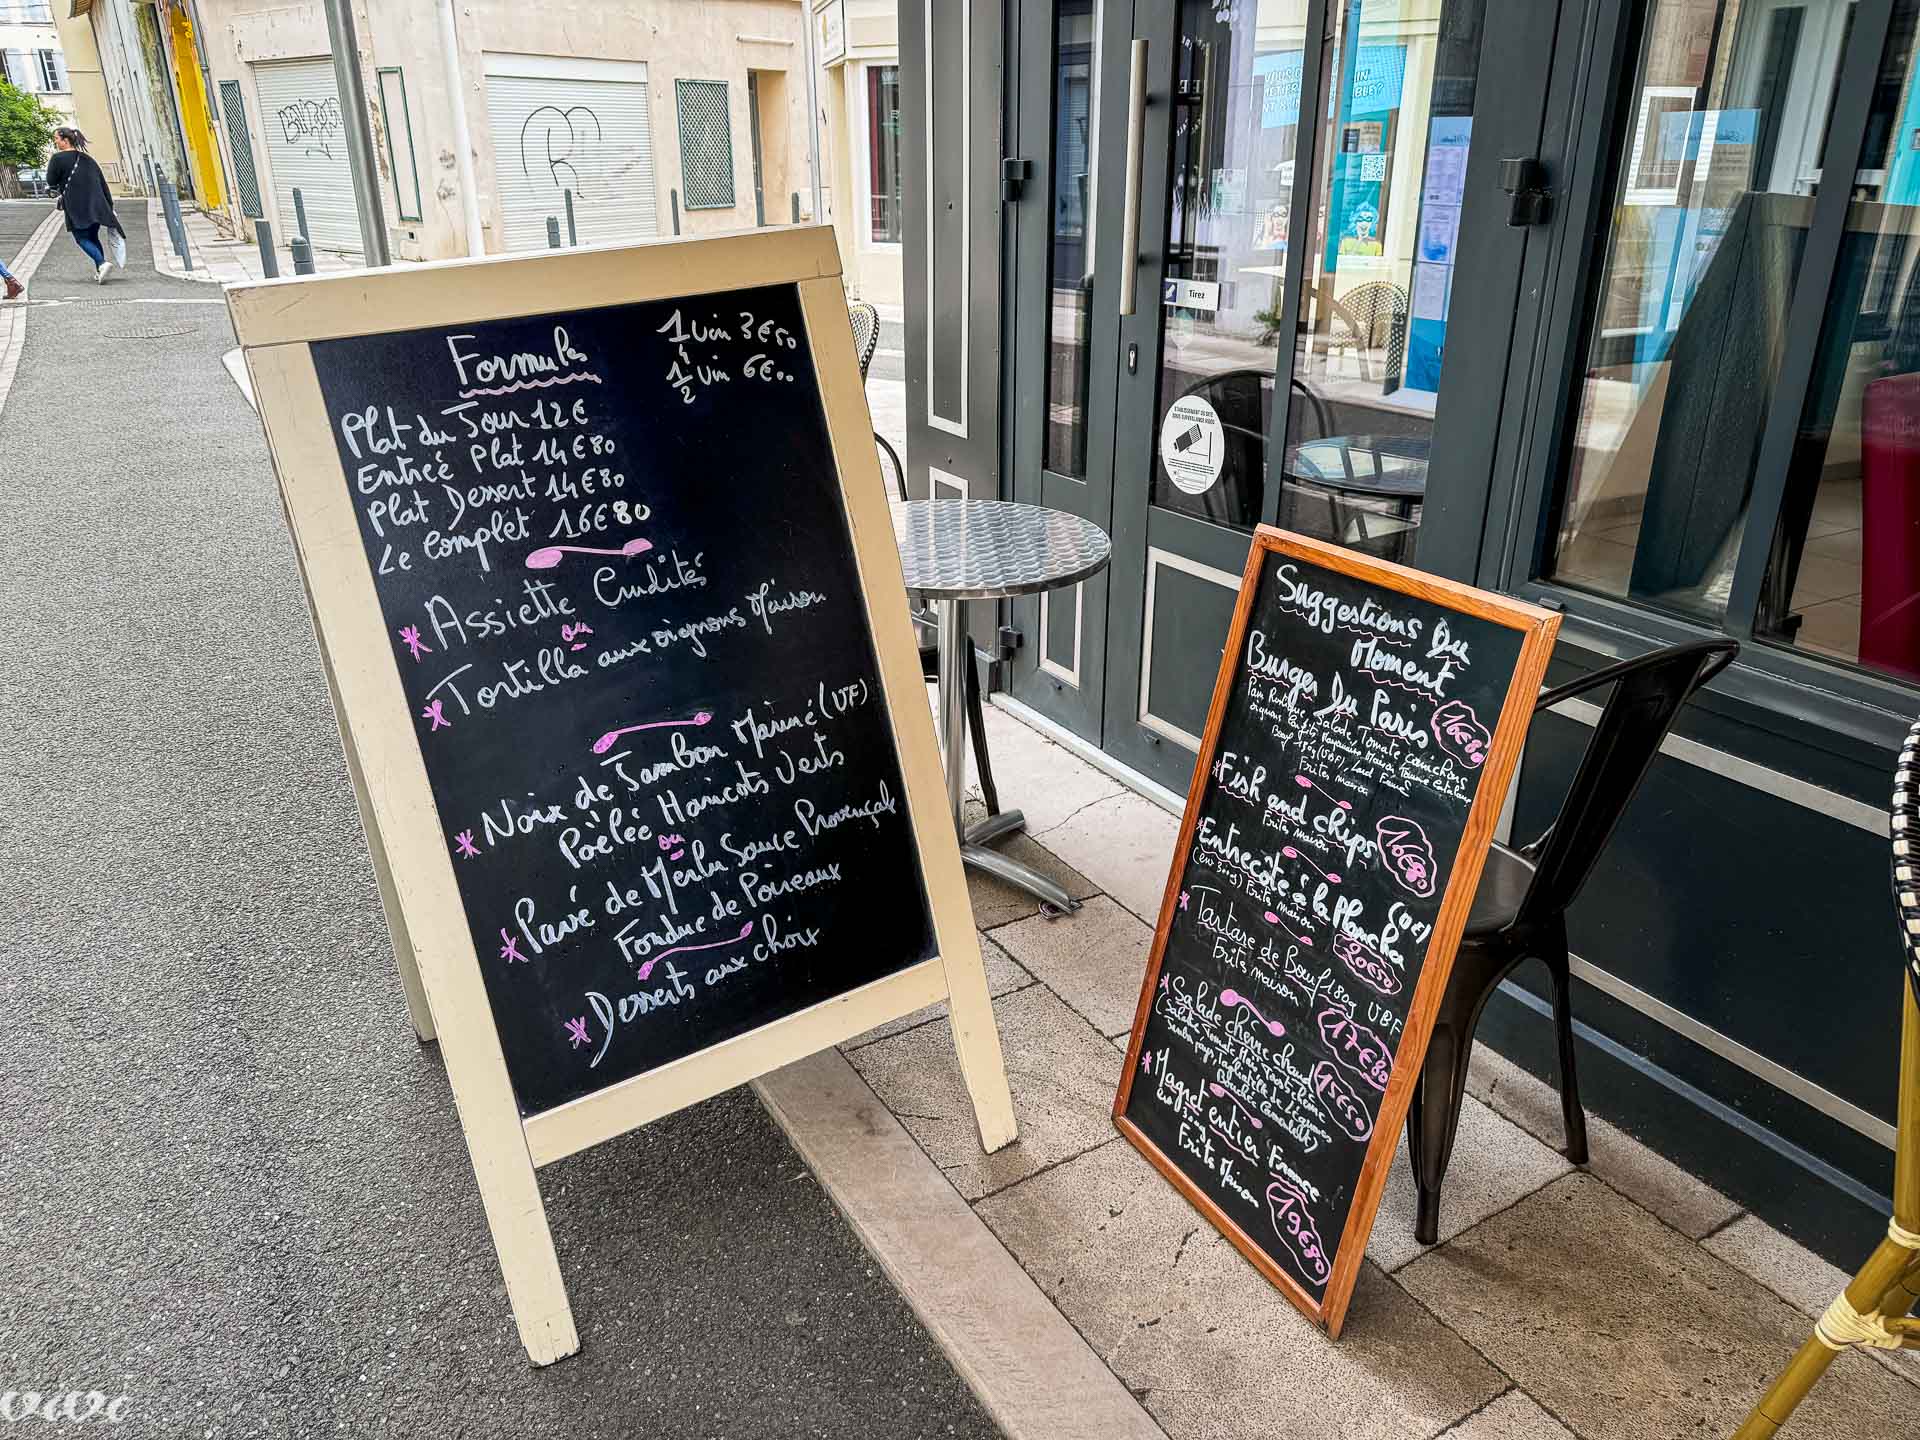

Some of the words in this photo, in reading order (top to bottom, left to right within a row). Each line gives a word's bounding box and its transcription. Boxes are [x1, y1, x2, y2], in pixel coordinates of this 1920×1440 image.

[691, 313, 732, 342] Vin
[1189, 289, 1205, 299] Tirez
[697, 354, 731, 385] Vin
[341, 405, 412, 458] Plat
[416, 415, 456, 446] du
[440, 400, 530, 438] Jour
[470, 434, 525, 472] Plat
[367, 490, 430, 537] Plat
[441, 470, 536, 530] Dessert
[378, 544, 412, 575] Le
[424, 506, 529, 572] Complet
[424, 579, 576, 649] Assiette
[1276, 564, 1423, 639] Suggestions
[427, 648, 589, 715] Tortilla
[598, 638, 652, 668] aux
[652, 608, 746, 658] oignons
[744, 579, 827, 634] Maison
[1247, 630, 1318, 707] Burger
[1370, 689, 1429, 749] Paris
[1351, 638, 1456, 698] Moment
[481, 791, 568, 846] Noix
[575, 776, 614, 811] de
[601, 731, 729, 792] Jambon
[657, 762, 769, 826] Haricots
[776, 733, 846, 786] Verts
[1219, 752, 1267, 800] Fish
[1267, 795, 1308, 826] and
[1313, 807, 1378, 868] chips
[514, 885, 596, 954] Pavé
[605, 880, 643, 916] de
[641, 840, 729, 915] Merlu
[721, 829, 801, 867] Sauce
[613, 914, 707, 963] Fondue
[712, 888, 740, 922] de
[739, 862, 843, 908] Poireaux
[1191, 884, 1256, 950] Tartare
[1260, 938, 1280, 962] de
[1199, 817, 1290, 896] Entrecôte
[1294, 874, 1309, 908] à
[1313, 882, 1331, 922] la
[1332, 895, 1405, 971] Plancha
[585, 962, 695, 1068] Desserts
[704, 956, 749, 985] aux
[753, 915, 821, 963] choix
[1172, 976, 1223, 1026] Salade
[1273, 1043, 1315, 1093] chaud
[1154, 1047, 1210, 1113] Magret
[1208, 1105, 1260, 1160] entier
